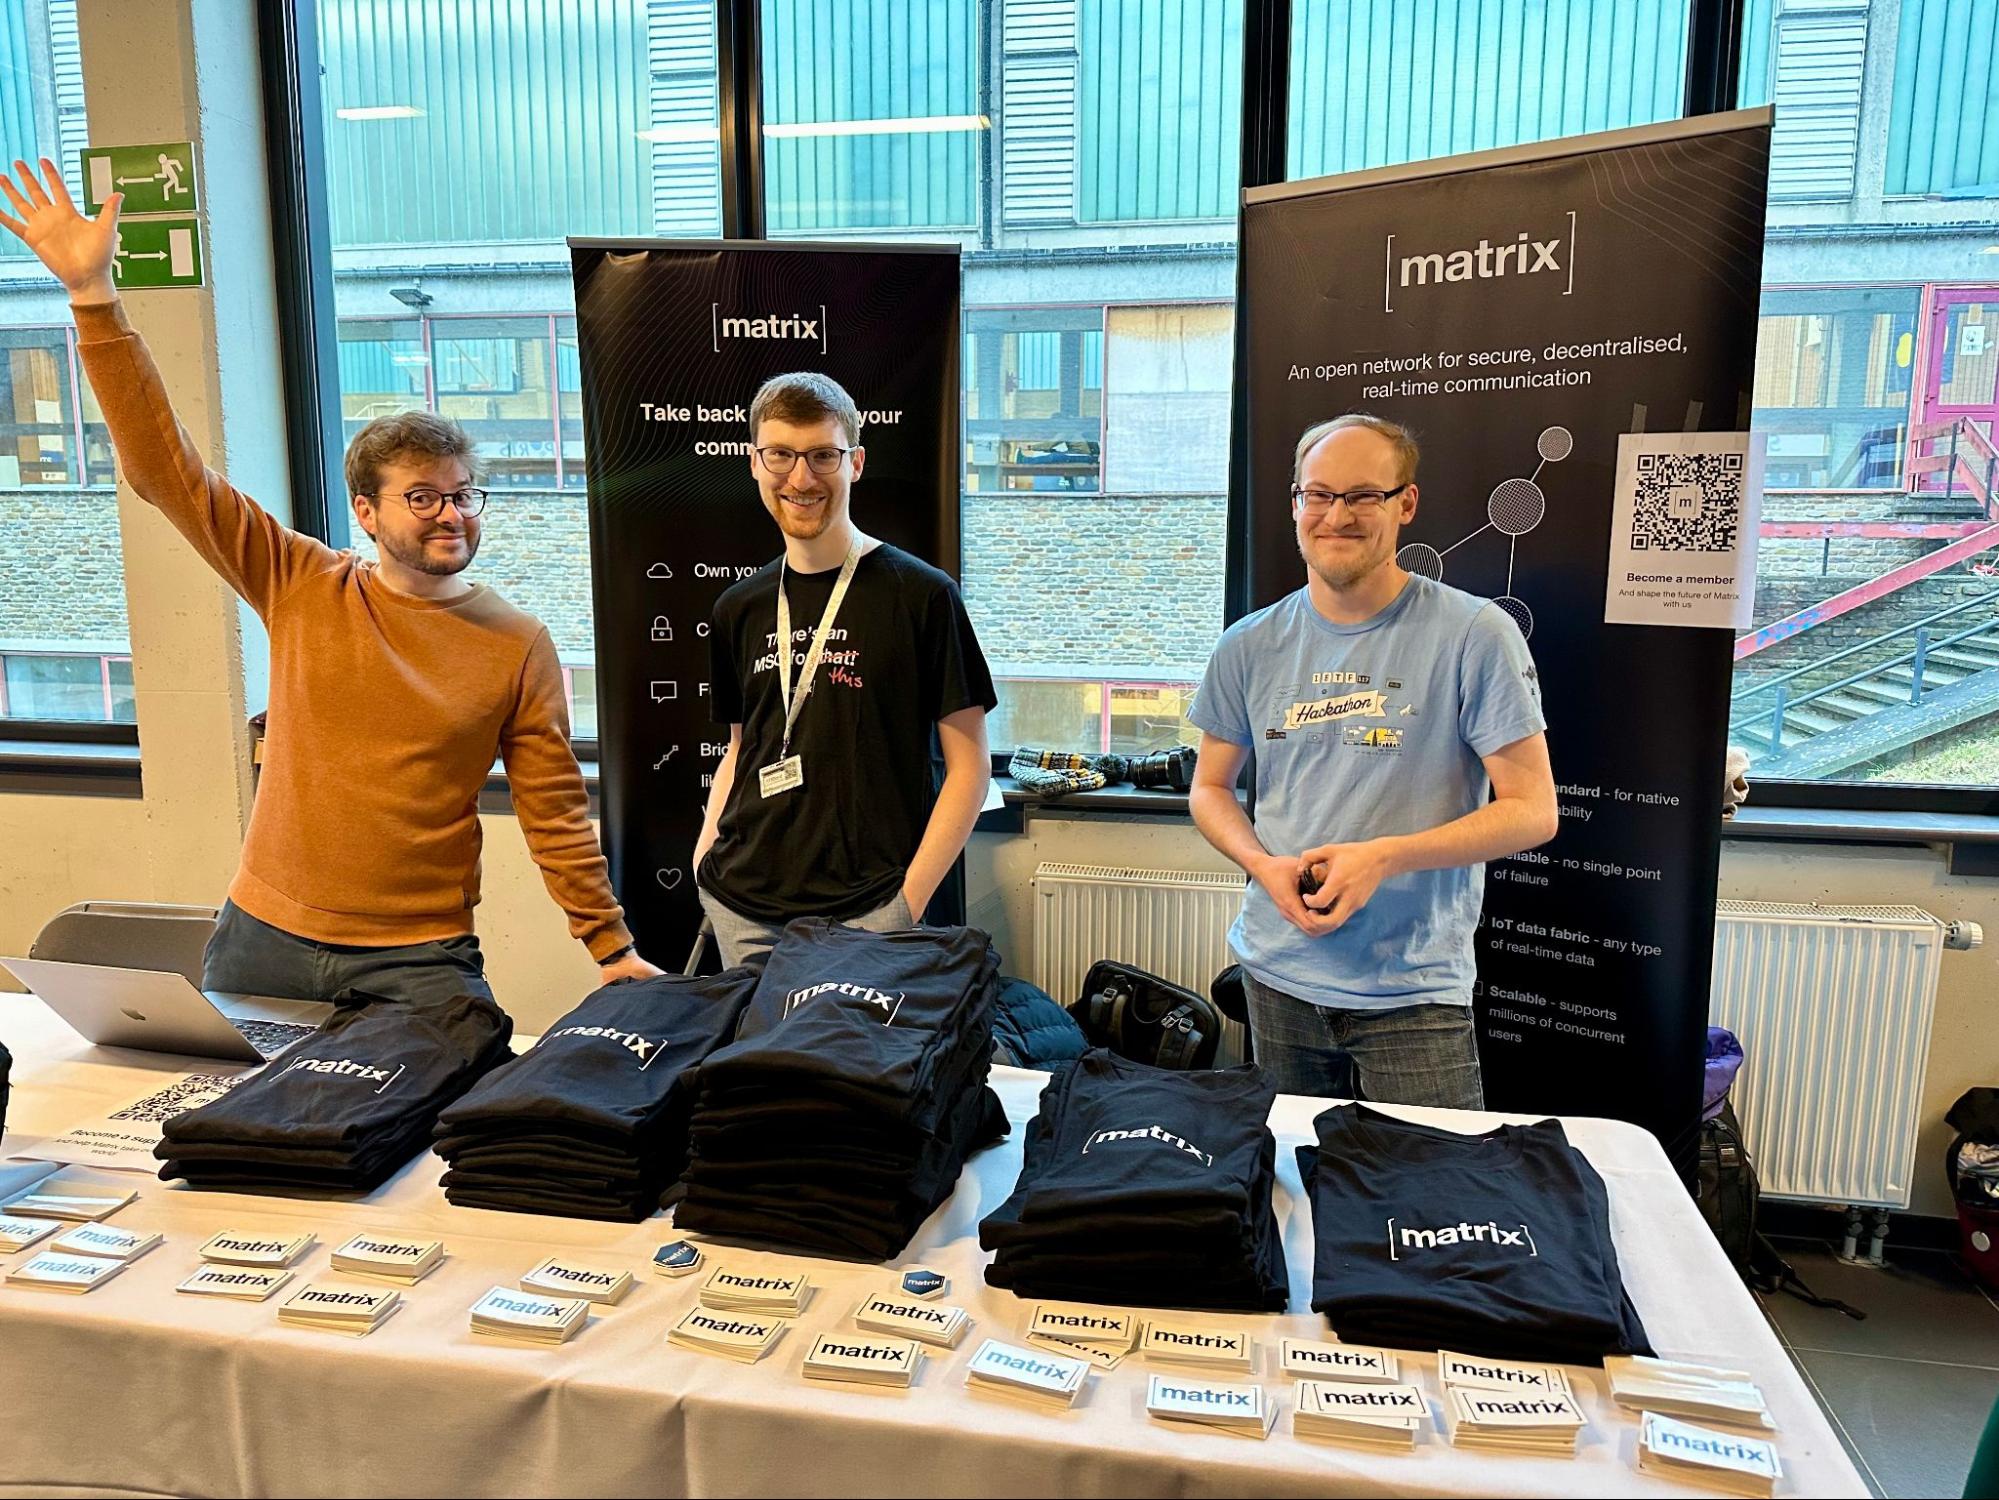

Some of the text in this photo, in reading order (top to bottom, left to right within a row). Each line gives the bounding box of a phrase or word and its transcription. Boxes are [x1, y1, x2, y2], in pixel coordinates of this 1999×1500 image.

[1288, 333, 1688, 381] An open network for secure, decentralised,
[1363, 369, 1591, 399] real-time communication
[640, 404, 902, 428] Take back your
[694, 563, 730, 578] Own
[1627, 572, 1673, 584] Become
[1686, 575, 1735, 585] member
[1619, 589, 1634, 597] And
[1637, 590, 1661, 598] shape
[1678, 591, 1701, 599] future
[1713, 592, 1740, 600] Matrix
[828, 666, 863, 688] this
[1296, 697, 1372, 722] Hackathon
[1614, 788, 1633, 801] for
[1637, 791, 1680, 806] native
[1494, 869, 1549, 886] of failure
[1563, 857, 1580, 870] no
[1583, 859, 1622, 877] single
[1626, 867, 1661, 881] point
[1492, 917, 1514, 930] IoT
[1517, 921, 1547, 936] data
[1550, 926, 1590, 944] fabric
[1603, 938, 1628, 953] any
[1631, 941, 1662, 957] type
[1491, 939, 1595, 967] of real-time data
[1489, 985, 1547, 1006] Scalable
[1559, 1000, 1617, 1021] supports
[1488, 1028, 1522, 1043] users
[1489, 1008, 1626, 1044] millions of concurrent
[70, 1129, 120, 1139] Become
